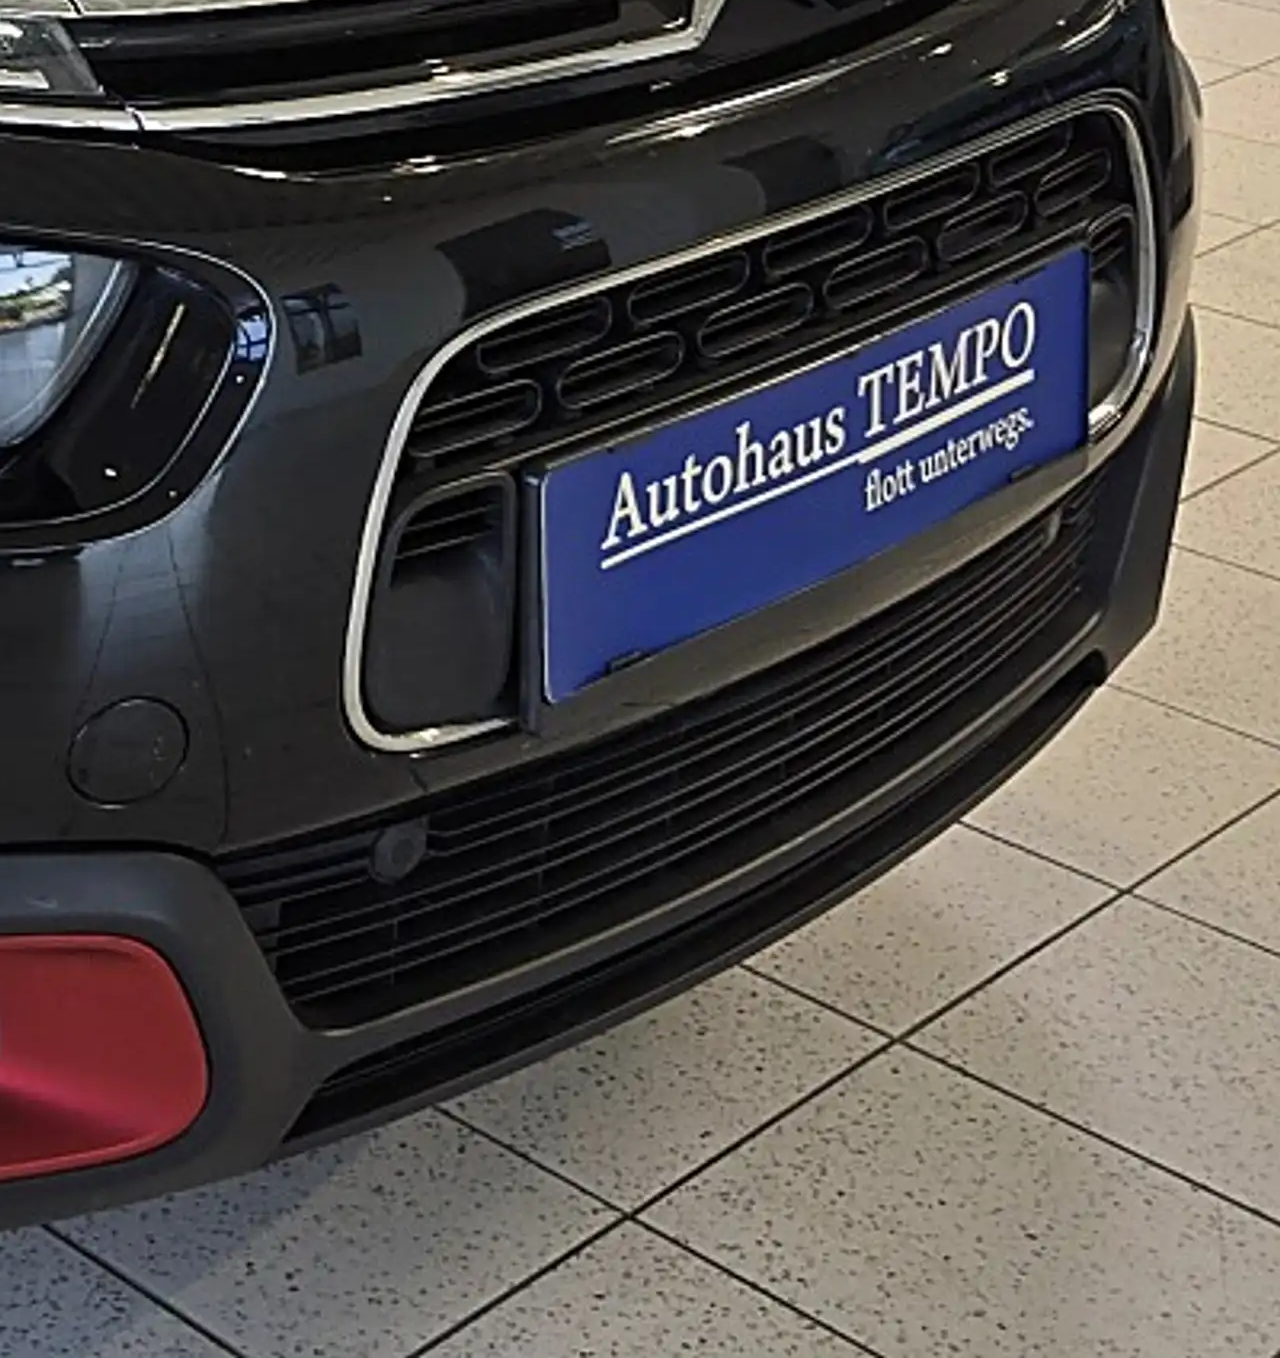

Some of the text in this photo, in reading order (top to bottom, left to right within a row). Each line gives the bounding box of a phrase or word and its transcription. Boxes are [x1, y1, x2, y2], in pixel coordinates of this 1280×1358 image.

[601, 301, 1036, 550] Autohaus TEMPO
[864, 407, 1035, 512] flott unterwegs.
